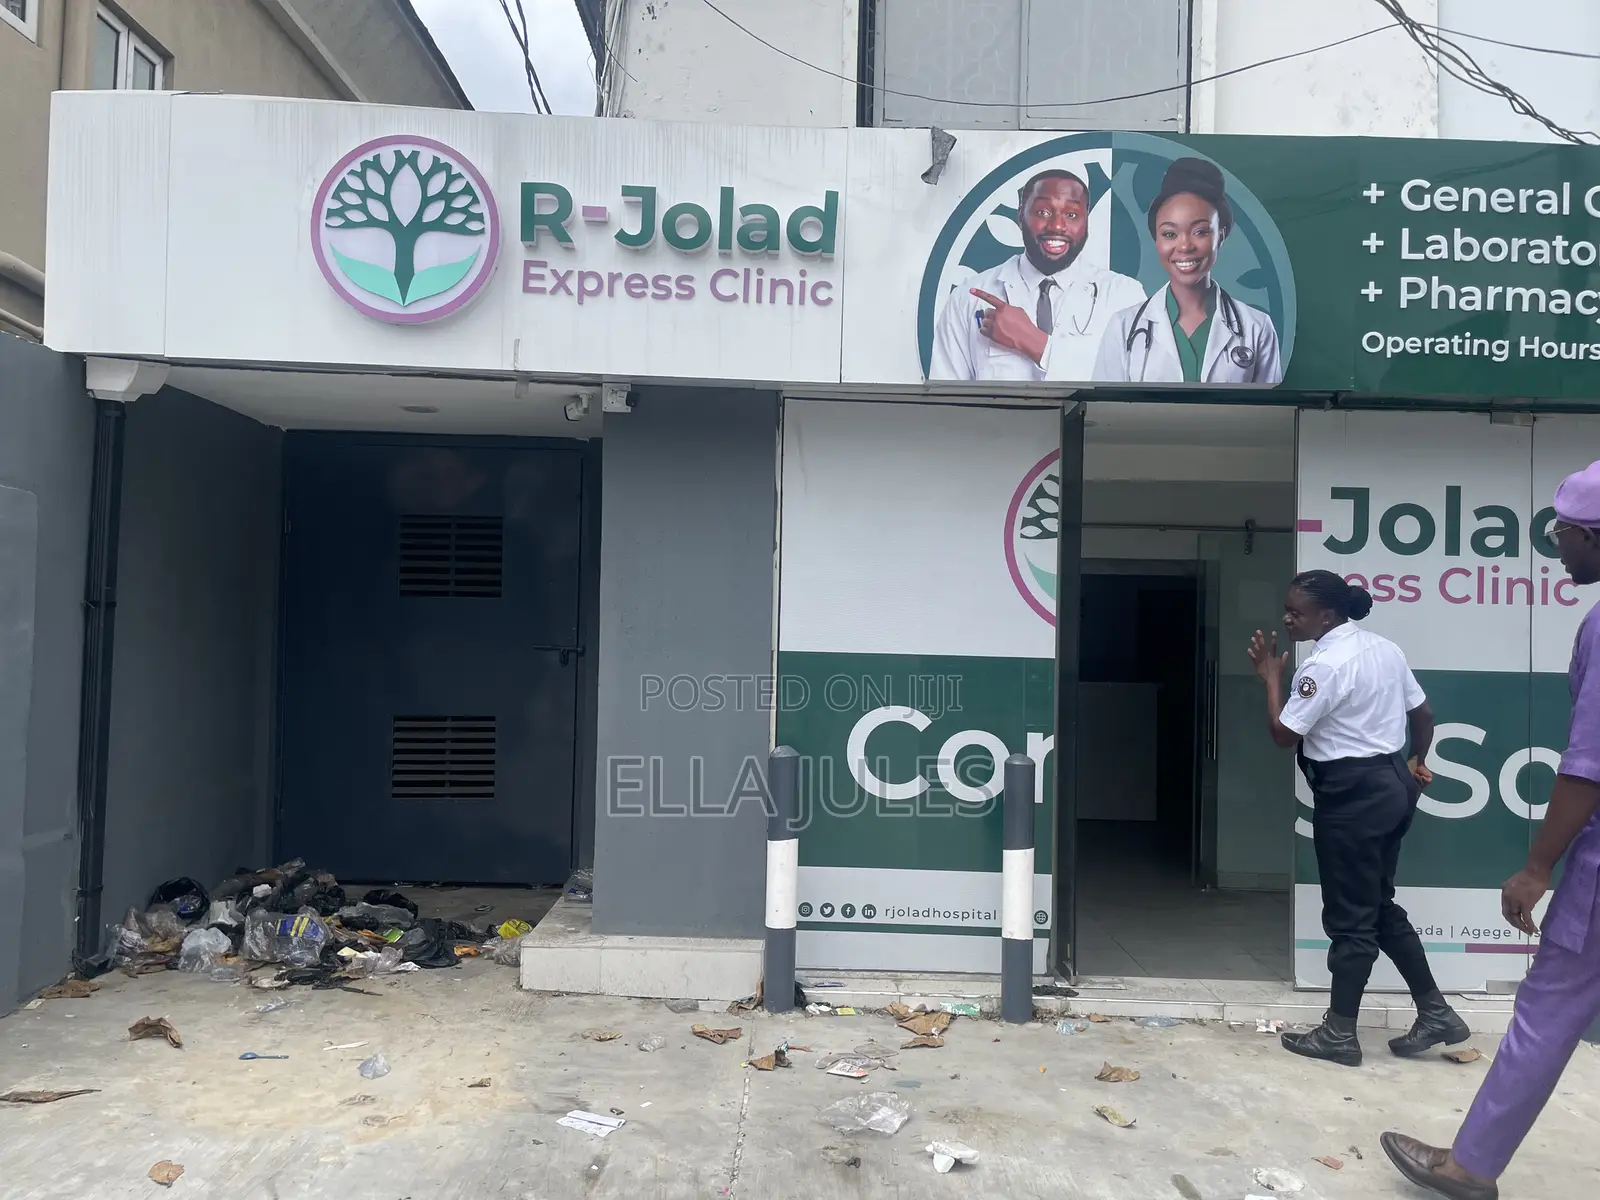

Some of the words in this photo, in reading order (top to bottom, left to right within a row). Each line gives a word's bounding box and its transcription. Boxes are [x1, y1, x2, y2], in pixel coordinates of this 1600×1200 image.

[1401, 178, 1571, 216] General
[520, 181, 840, 257] R-Jolad
[1401, 227, 1600, 267] Laborato
[521, 259, 696, 306] Express
[709, 267, 834, 306] Clinic
[1400, 275, 1600, 325] Pharmac
[1361, 331, 1510, 362] Operating
[1519, 335, 1600, 361] Hours
[1438, 564, 1580, 607] Clinic
[884, 906, 997, 921] rjoladhospital
[1460, 925, 1512, 940] Agege
